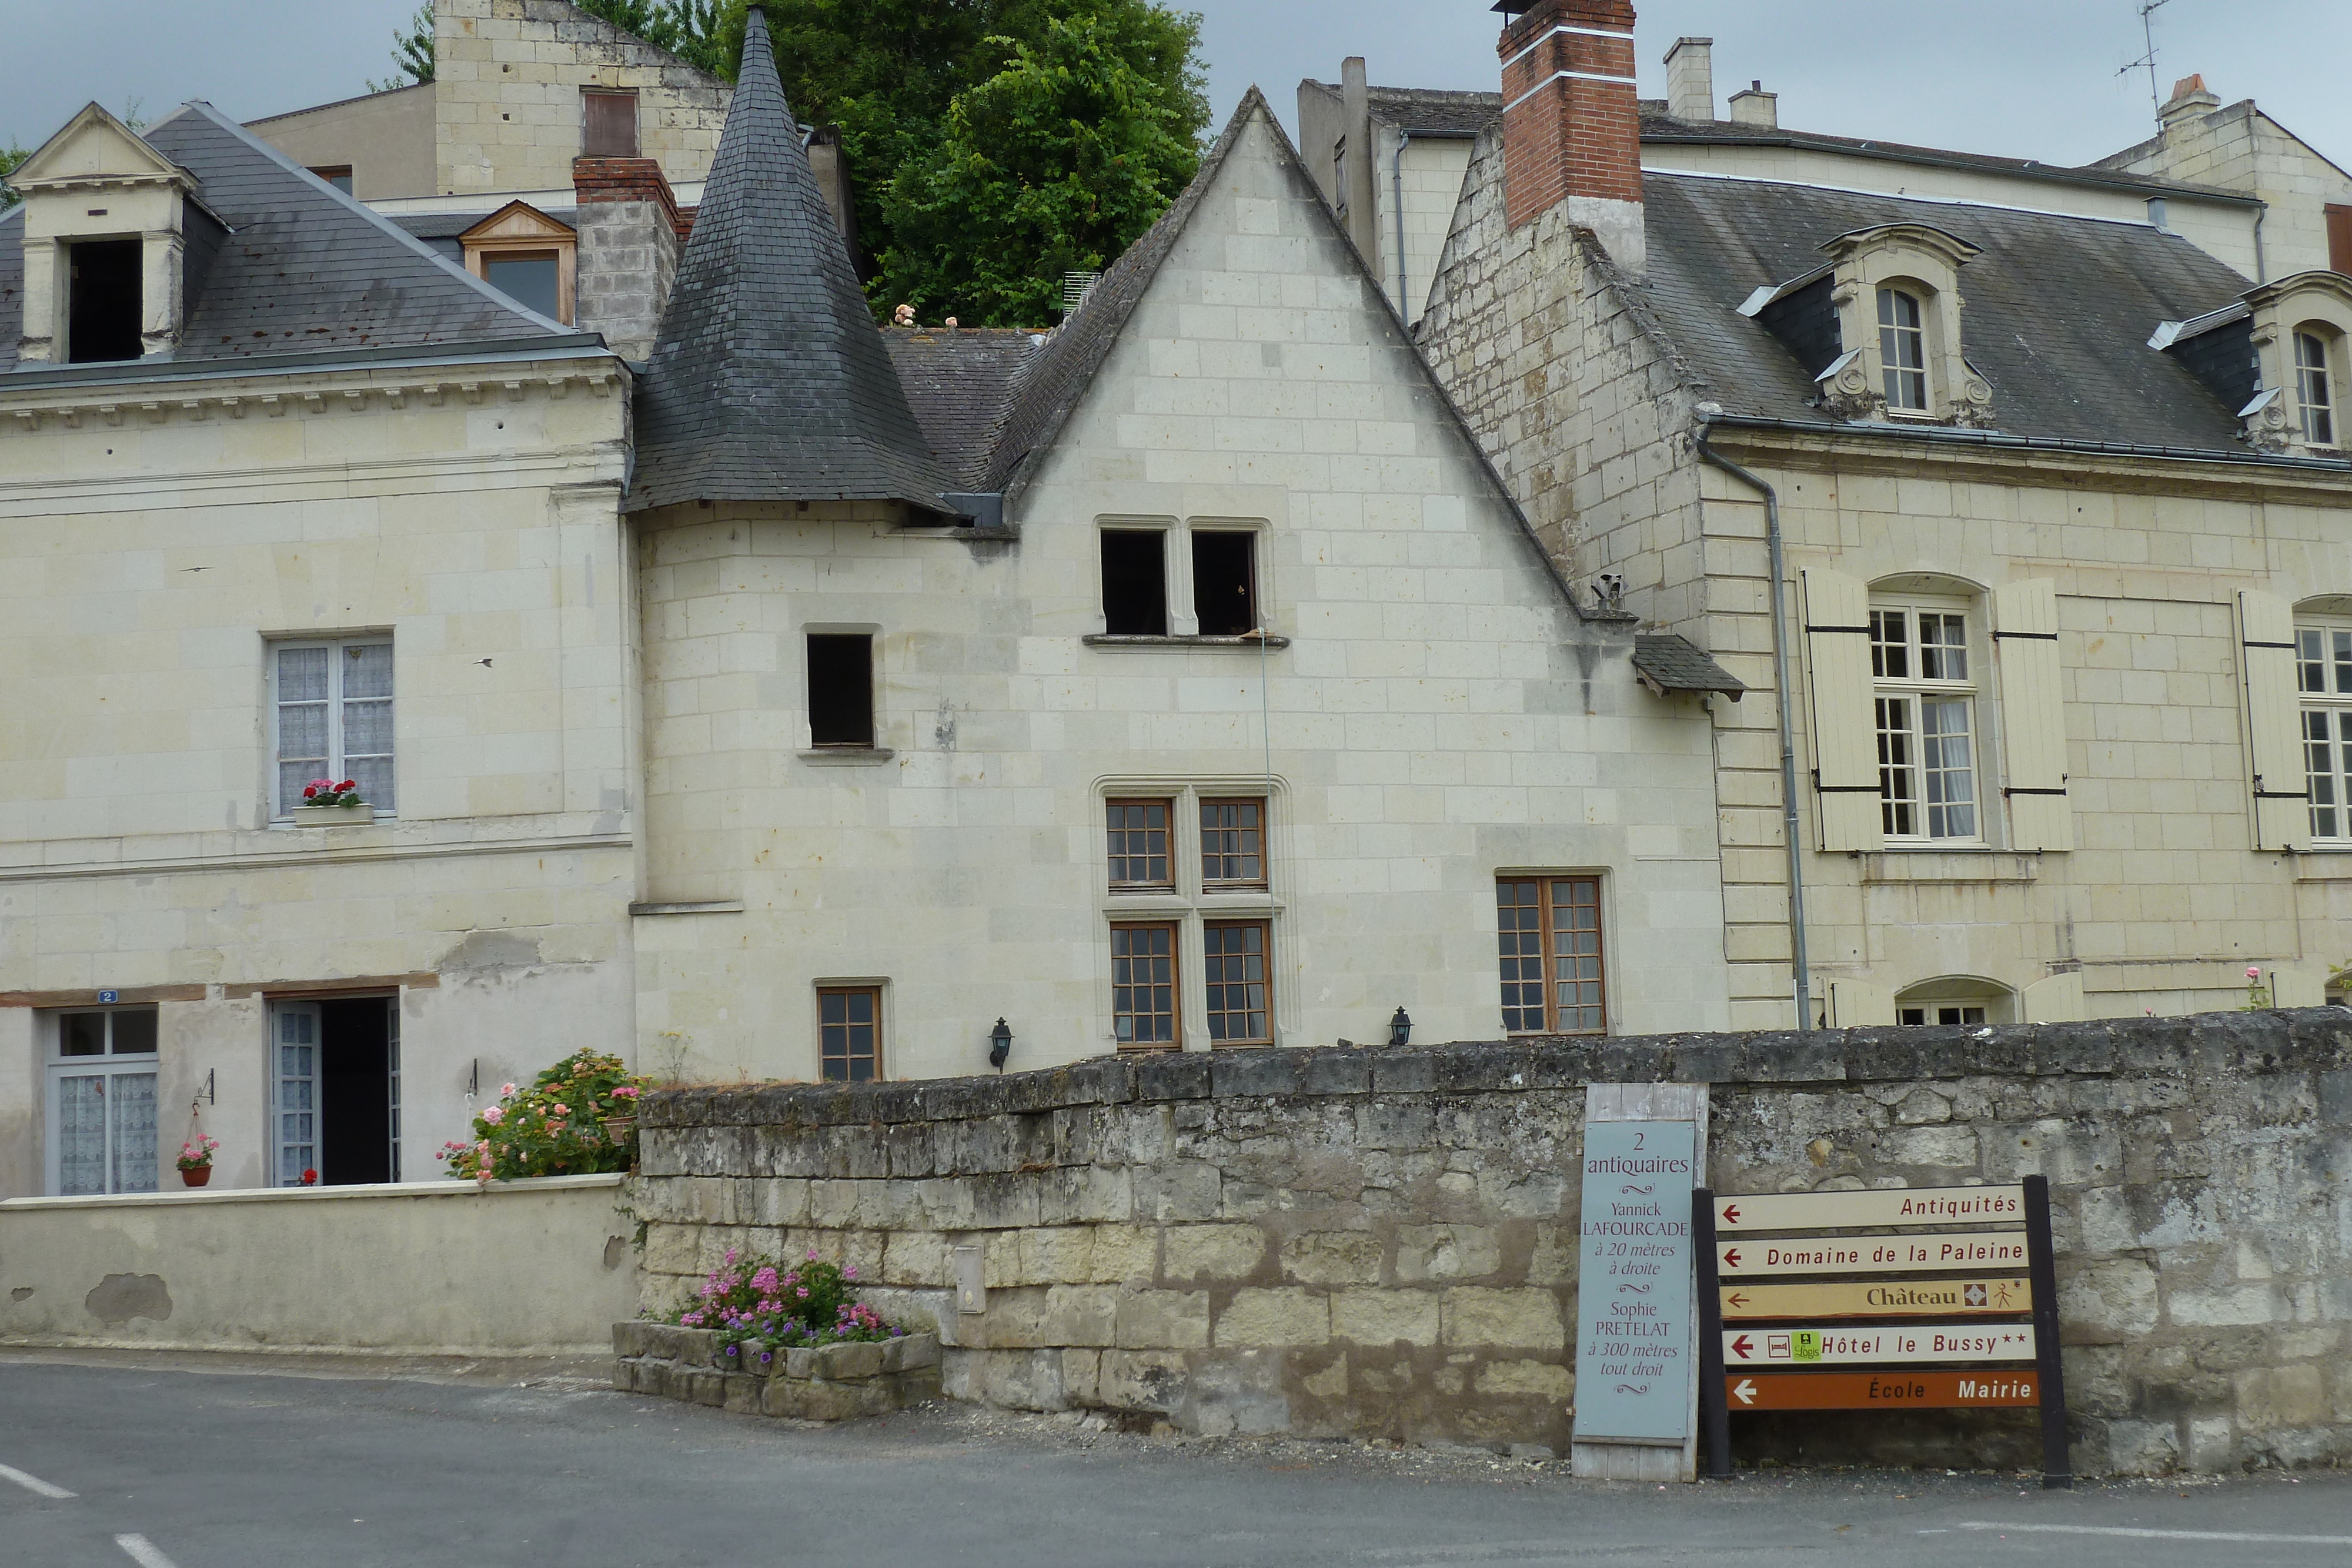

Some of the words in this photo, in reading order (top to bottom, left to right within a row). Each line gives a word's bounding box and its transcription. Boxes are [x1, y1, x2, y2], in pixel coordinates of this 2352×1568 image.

[104, 992, 112, 1001] 2
[1633, 1132, 1644, 1150] 2
[1588, 1155, 1688, 1176] antiquaires
[1611, 1202, 1661, 1216] Yannick
[1900, 1195, 2016, 1218] Antiquités
[1583, 1222, 1688, 1236] LAFOURCADE
[1595, 1242, 1602, 1256] à
[1608, 1242, 1626, 1256] 20
[1631, 1242, 1675, 1256] mètres
[1767, 1247, 1858, 1265] Domaine
[1873, 1246, 1896, 1262] de
[1909, 1245, 1927, 1261] la
[1940, 1242, 2023, 1261] Paleine
[1609, 1261, 1617, 1275] à
[1622, 1261, 1661, 1275] droite
[1866, 1288, 1957, 1306] Château
[1611, 1301, 1657, 1321] Sophie
[1596, 1322, 1671, 1336] PRETELAT
[1588, 1342, 1596, 1356] à
[1601, 1342, 1629, 1356] 300
[1633, 1343, 1678, 1358] mètres
[1795, 1345, 1819, 1359] Logis
[1822, 1336, 1880, 1353] Hôtel
[1897, 1335, 1916, 1353] le
[1933, 1335, 1997, 1355] Bussy
[1601, 1362, 1628, 1375] tout
[1632, 1361, 1663, 1376] droit
[1869, 1377, 1925, 1399] École
[1958, 1380, 2032, 1398] Mairie
